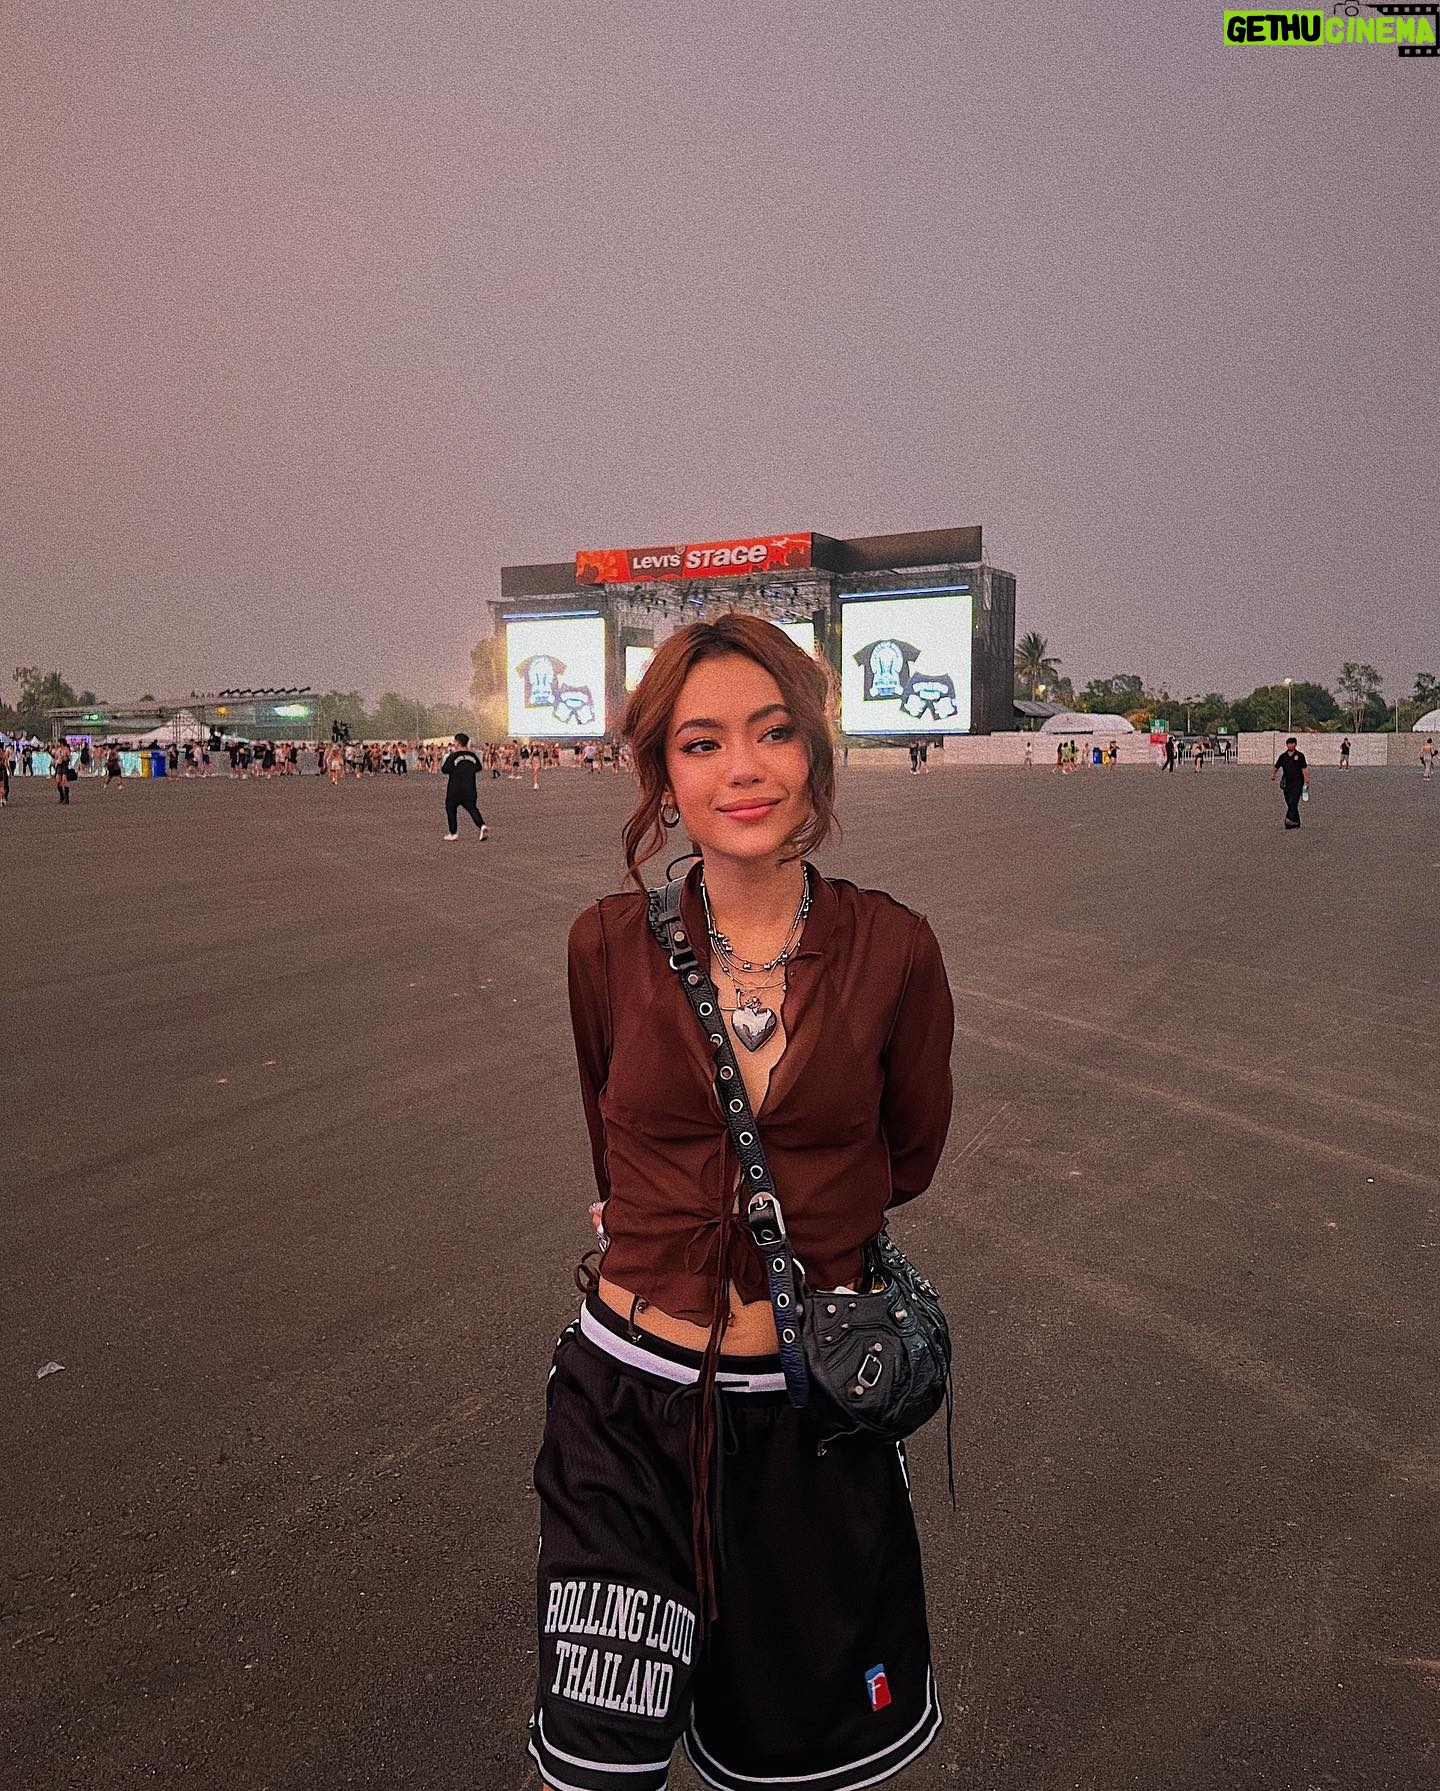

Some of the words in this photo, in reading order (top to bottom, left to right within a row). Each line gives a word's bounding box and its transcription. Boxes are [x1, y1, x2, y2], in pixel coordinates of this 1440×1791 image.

[544, 1581, 648, 1643] ROLLING
[645, 1594, 696, 1666] LOUD
[551, 1639, 674, 1718] THAILAND
